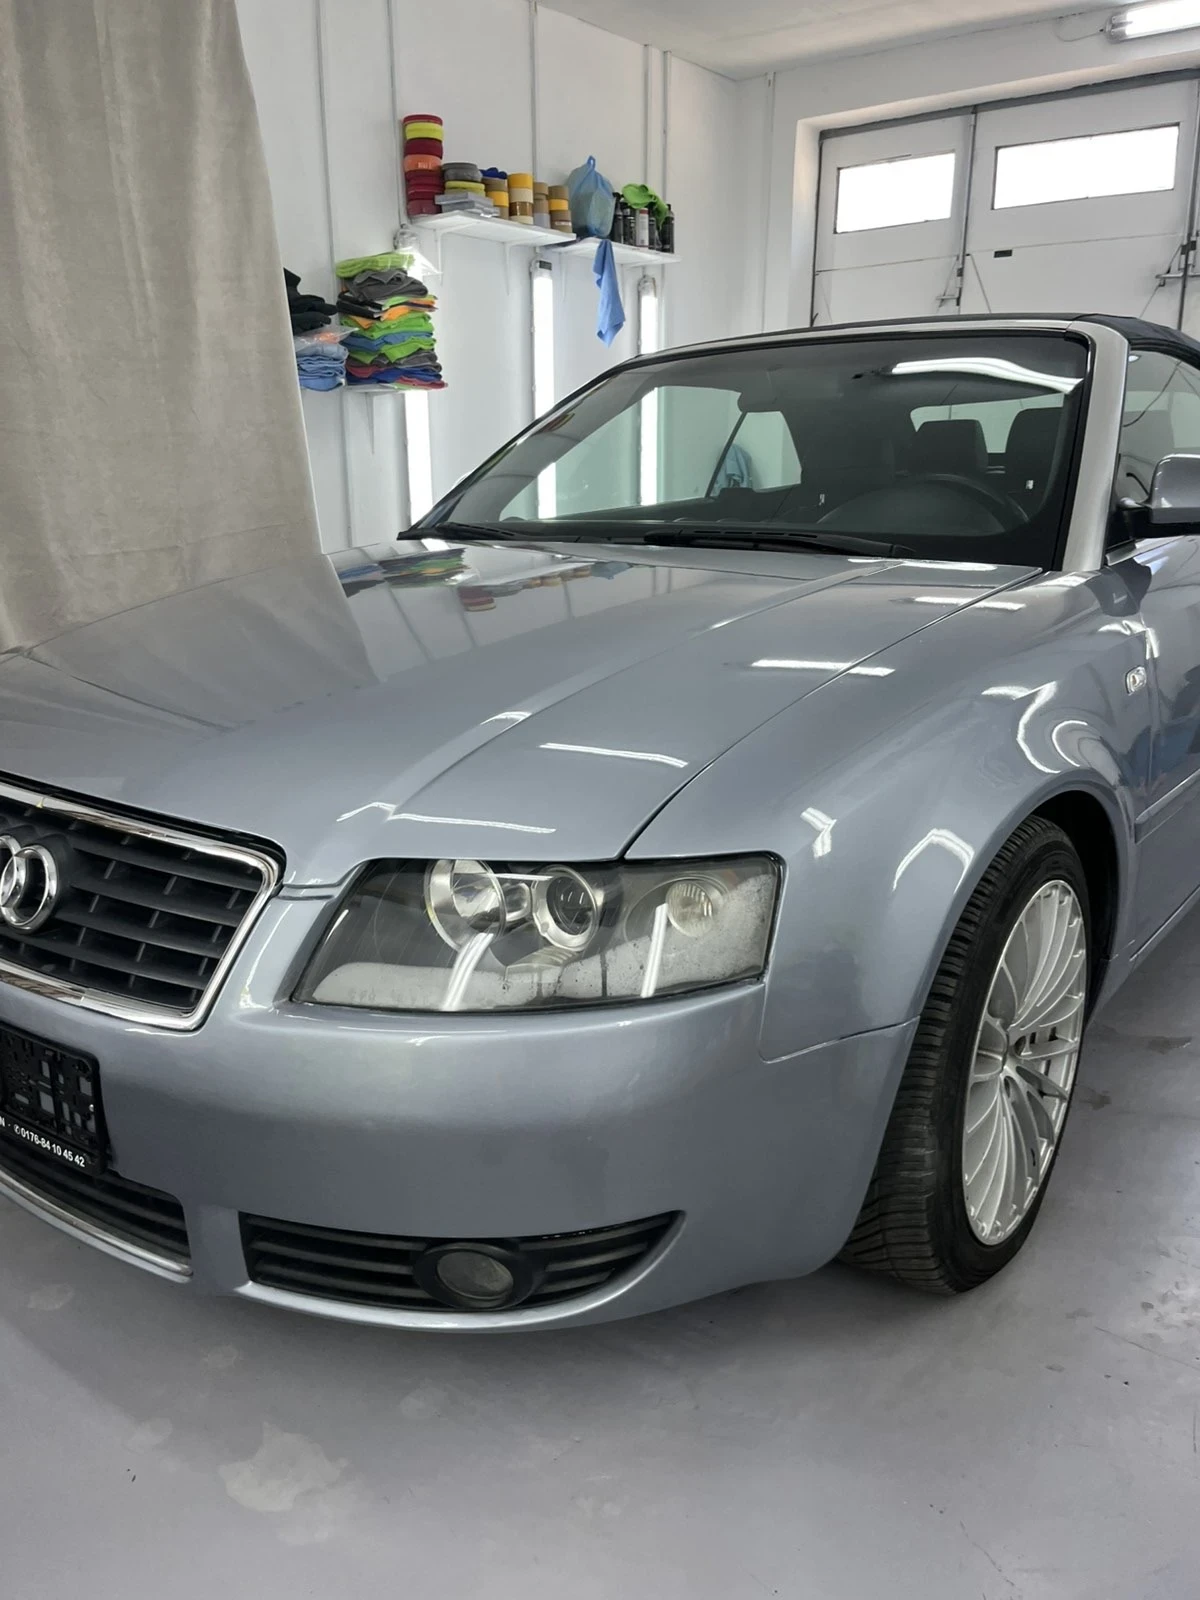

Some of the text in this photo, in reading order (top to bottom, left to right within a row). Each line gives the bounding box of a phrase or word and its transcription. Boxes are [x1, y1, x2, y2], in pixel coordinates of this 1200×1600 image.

[52, 1143, 62, 1156] 10
[63, 1149, 74, 1162] 45
[74, 1154, 86, 1168] 42
